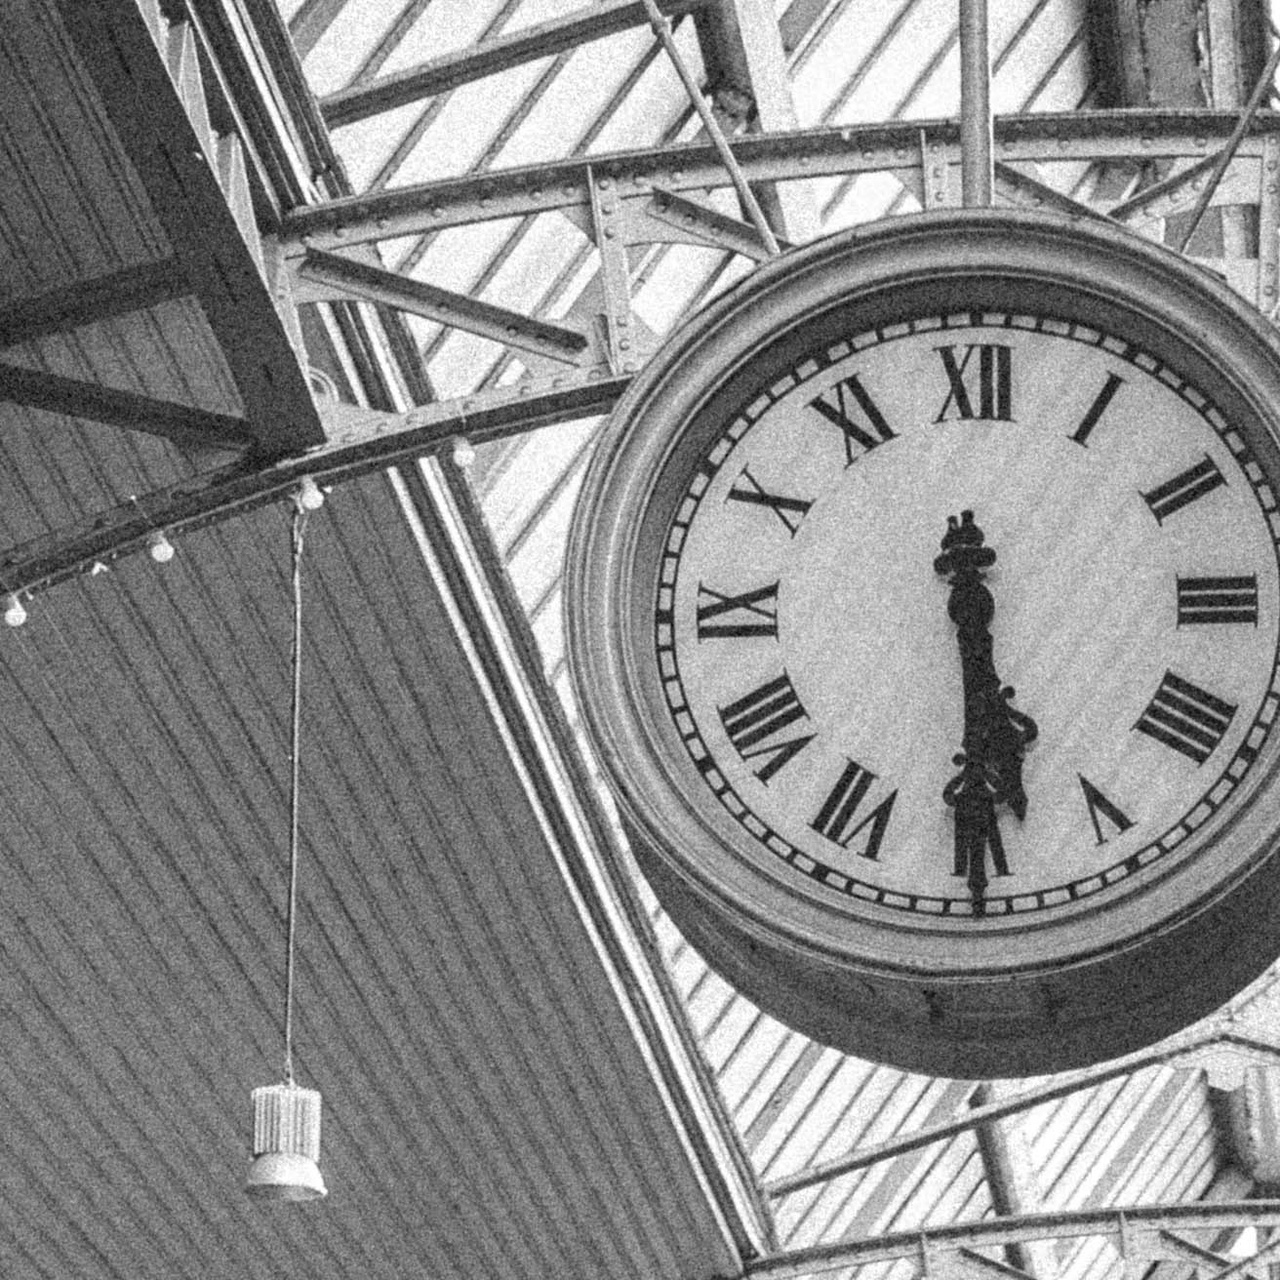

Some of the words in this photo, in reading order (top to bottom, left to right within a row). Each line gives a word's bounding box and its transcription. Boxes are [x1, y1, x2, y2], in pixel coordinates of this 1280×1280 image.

[805, 373, 900, 468] XI
[933, 343, 1014, 423] XII
[1068, 371, 1126, 447] I
[726, 465, 815, 538] X
[1139, 453, 1229, 527] II
[696, 580, 780, 642] IX
[1176, 573, 1260, 629] III
[717, 669, 818, 788] VIII
[1131, 668, 1239, 767] IIII
[809, 758, 899, 862] VII
[1078, 773, 1138, 846] V
